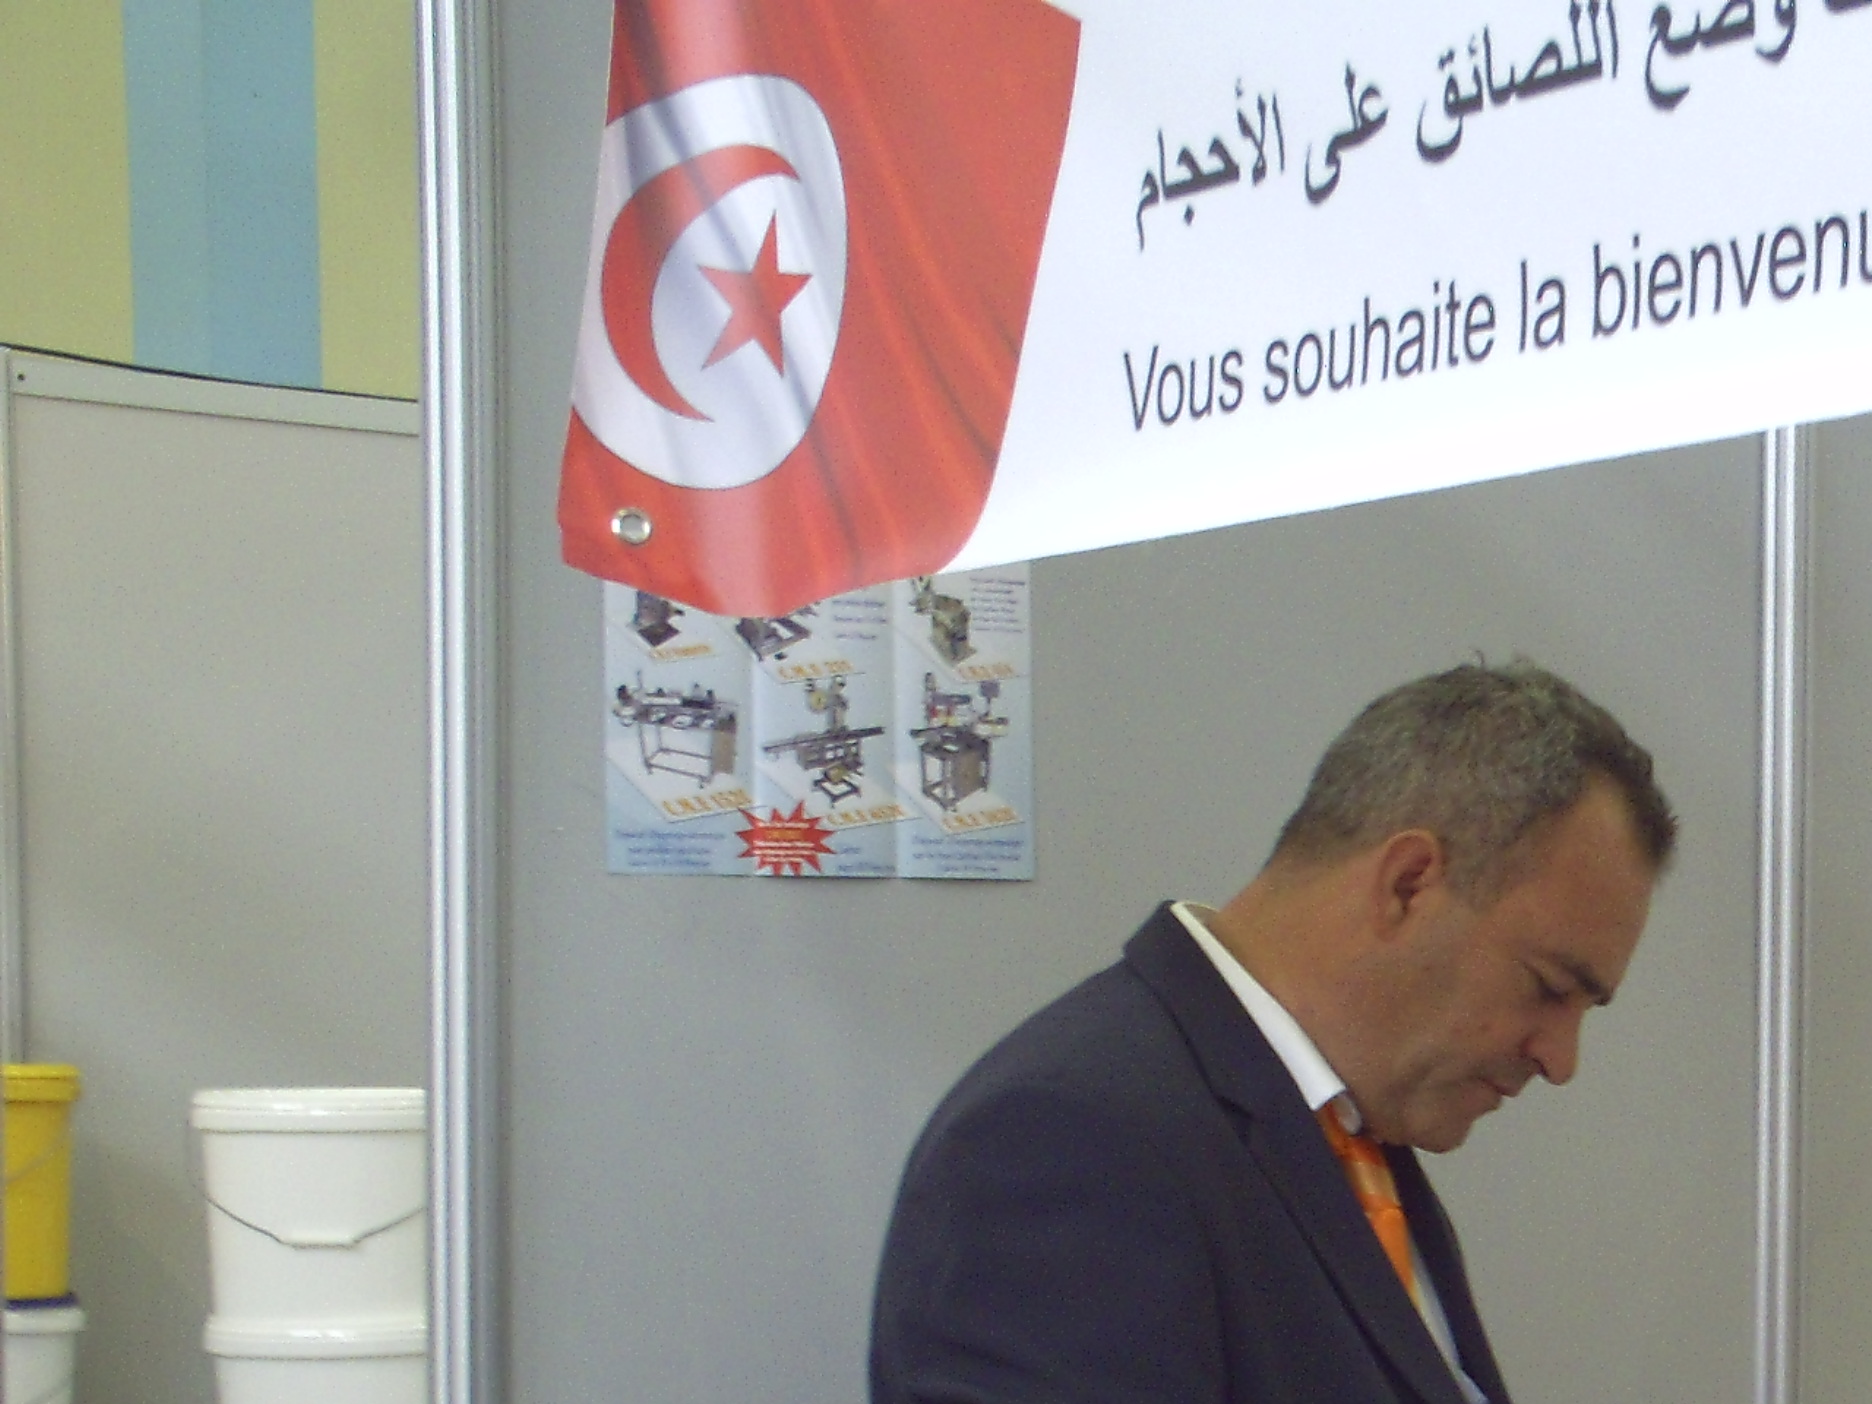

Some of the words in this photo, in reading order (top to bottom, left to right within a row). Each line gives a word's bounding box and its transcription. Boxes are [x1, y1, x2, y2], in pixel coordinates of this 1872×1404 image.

[1136, 78, 1286, 251] الأحجام
[1304, 66, 1389, 205] على
[1123, 347, 1243, 430] Vous
[1263, 282, 1496, 404] souhaite
[1520, 261, 1566, 350] la
